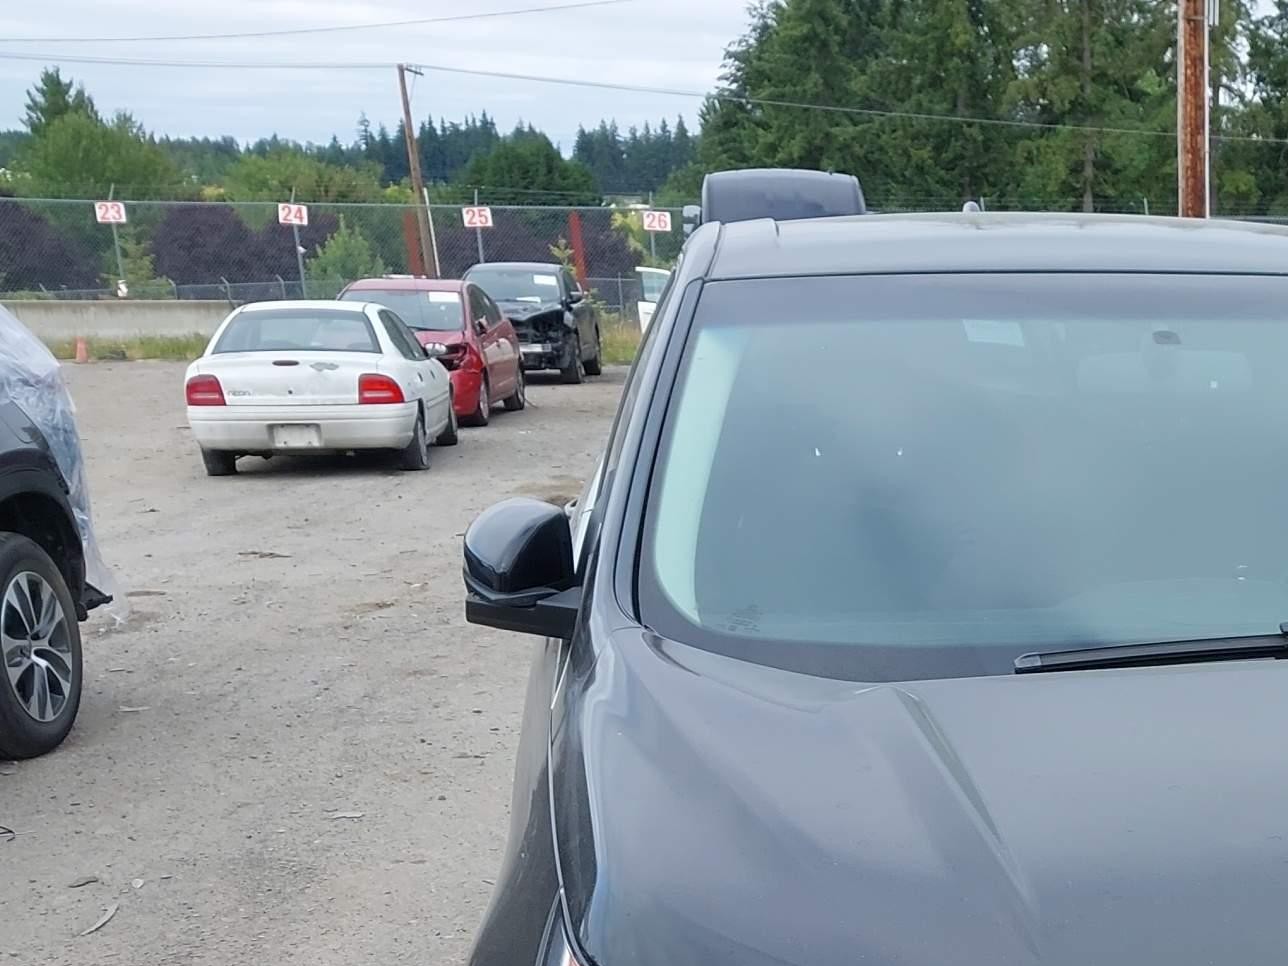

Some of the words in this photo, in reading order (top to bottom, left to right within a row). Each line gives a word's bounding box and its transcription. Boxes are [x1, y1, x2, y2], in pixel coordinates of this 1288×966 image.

[99, 203, 123, 221] 23
[282, 204, 304, 222] 24
[465, 209, 489, 226] 25
[645, 213, 668, 229] 26
